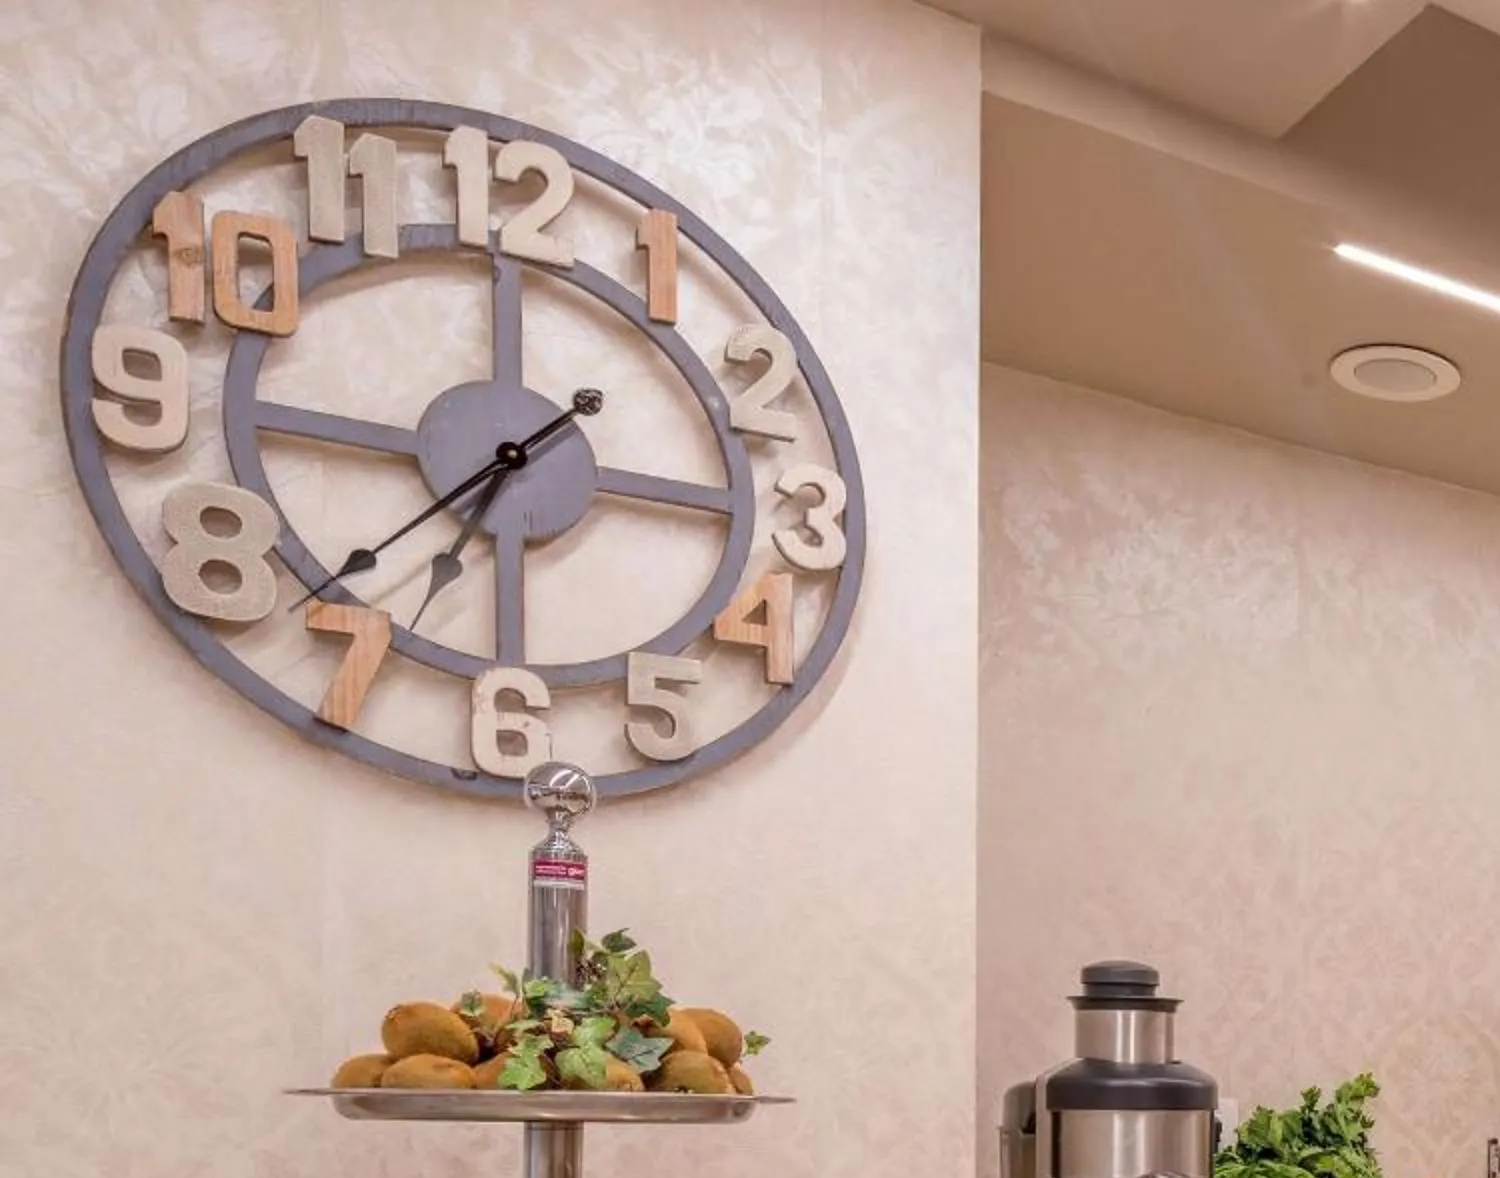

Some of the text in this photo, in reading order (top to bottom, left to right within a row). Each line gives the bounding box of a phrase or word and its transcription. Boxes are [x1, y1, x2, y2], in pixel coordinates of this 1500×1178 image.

[294, 115, 399, 259] 11
[443, 125, 576, 268] 12
[153, 191, 300, 338] 10
[635, 209, 680, 325] 1
[91, 324, 190, 454] 9
[724, 324, 799, 443] 2
[160, 481, 281, 623] 8
[771, 463, 847, 572] 3
[304, 600, 393, 732] 7
[712, 572, 795, 686] 4
[470, 665, 552, 780] 6
[624, 651, 702, 764] 5
